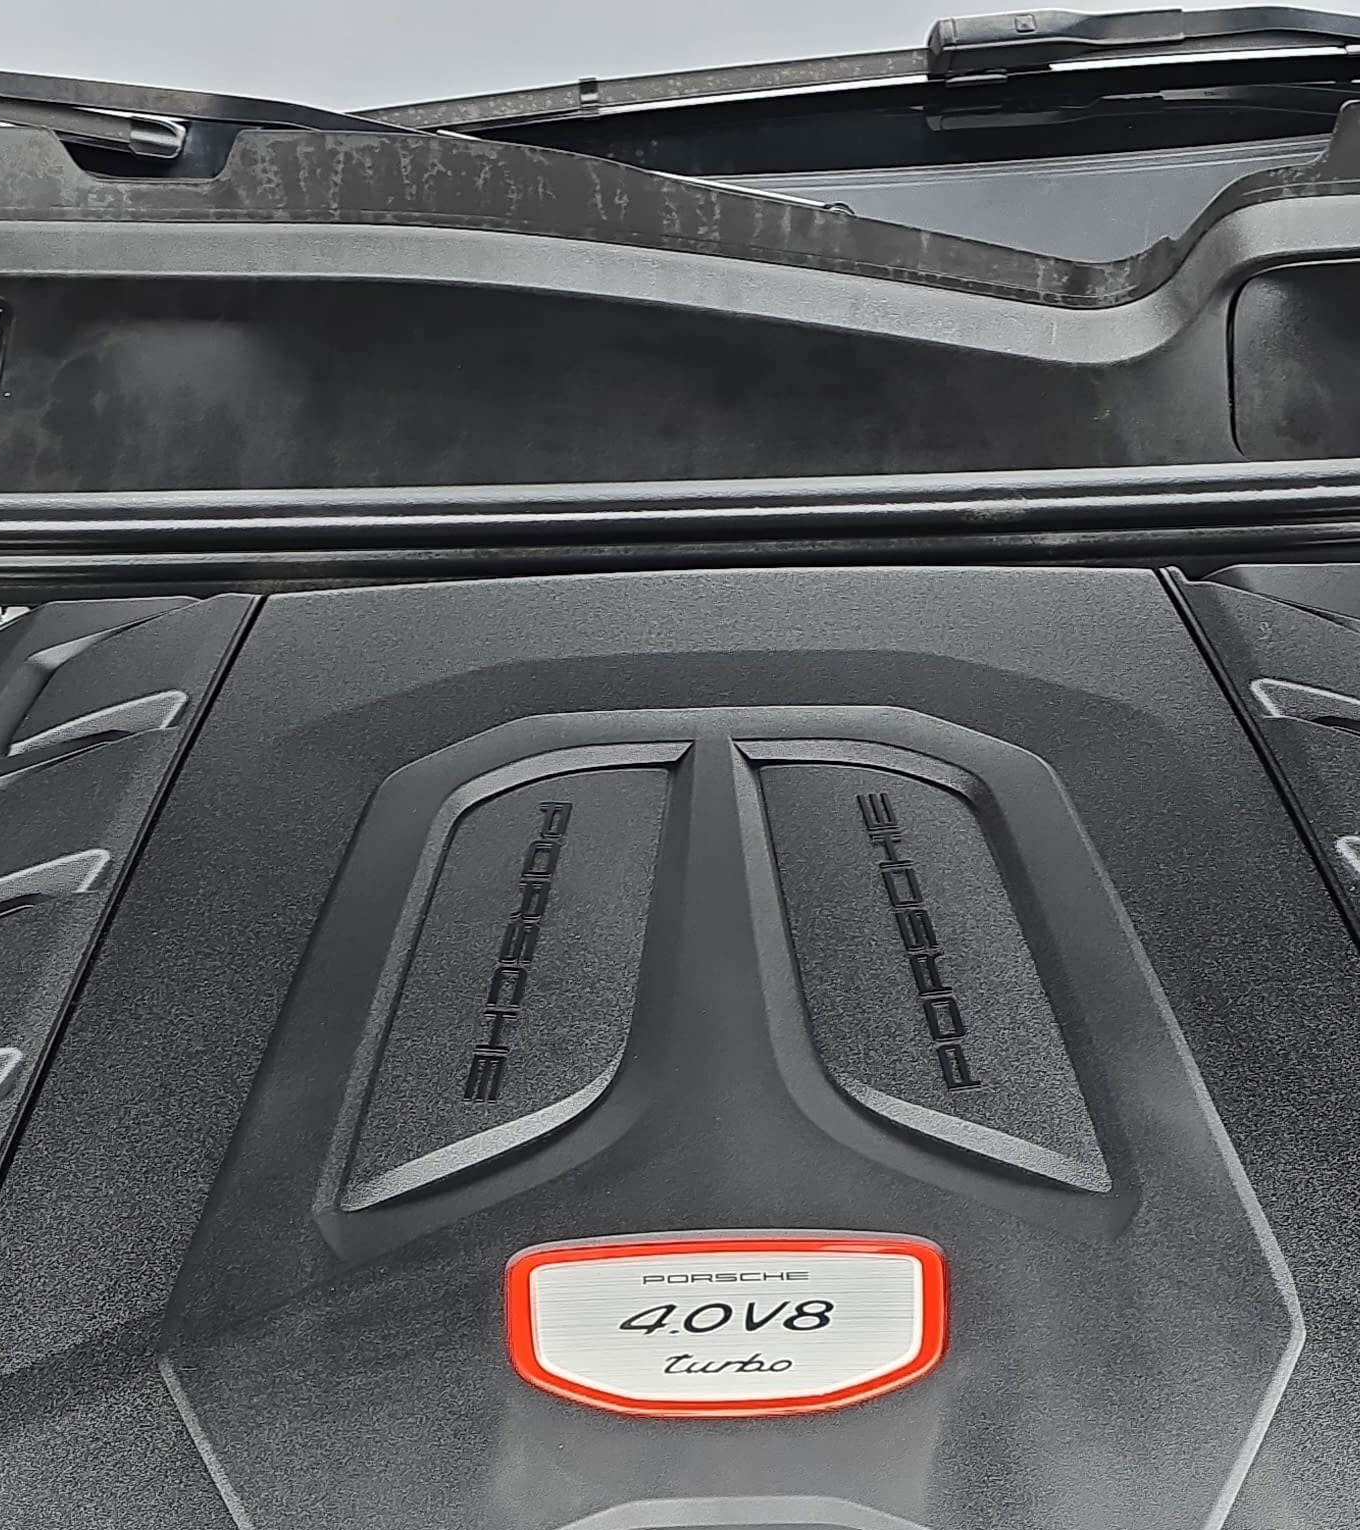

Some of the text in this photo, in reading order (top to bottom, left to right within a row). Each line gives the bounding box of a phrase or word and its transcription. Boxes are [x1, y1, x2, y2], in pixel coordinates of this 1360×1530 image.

[464, 800, 574, 1104] PORSCHE
[856, 791, 981, 1092] PORSCHE
[642, 1271, 810, 1286] PORSCHE
[662, 1352, 793, 1376] turbo
